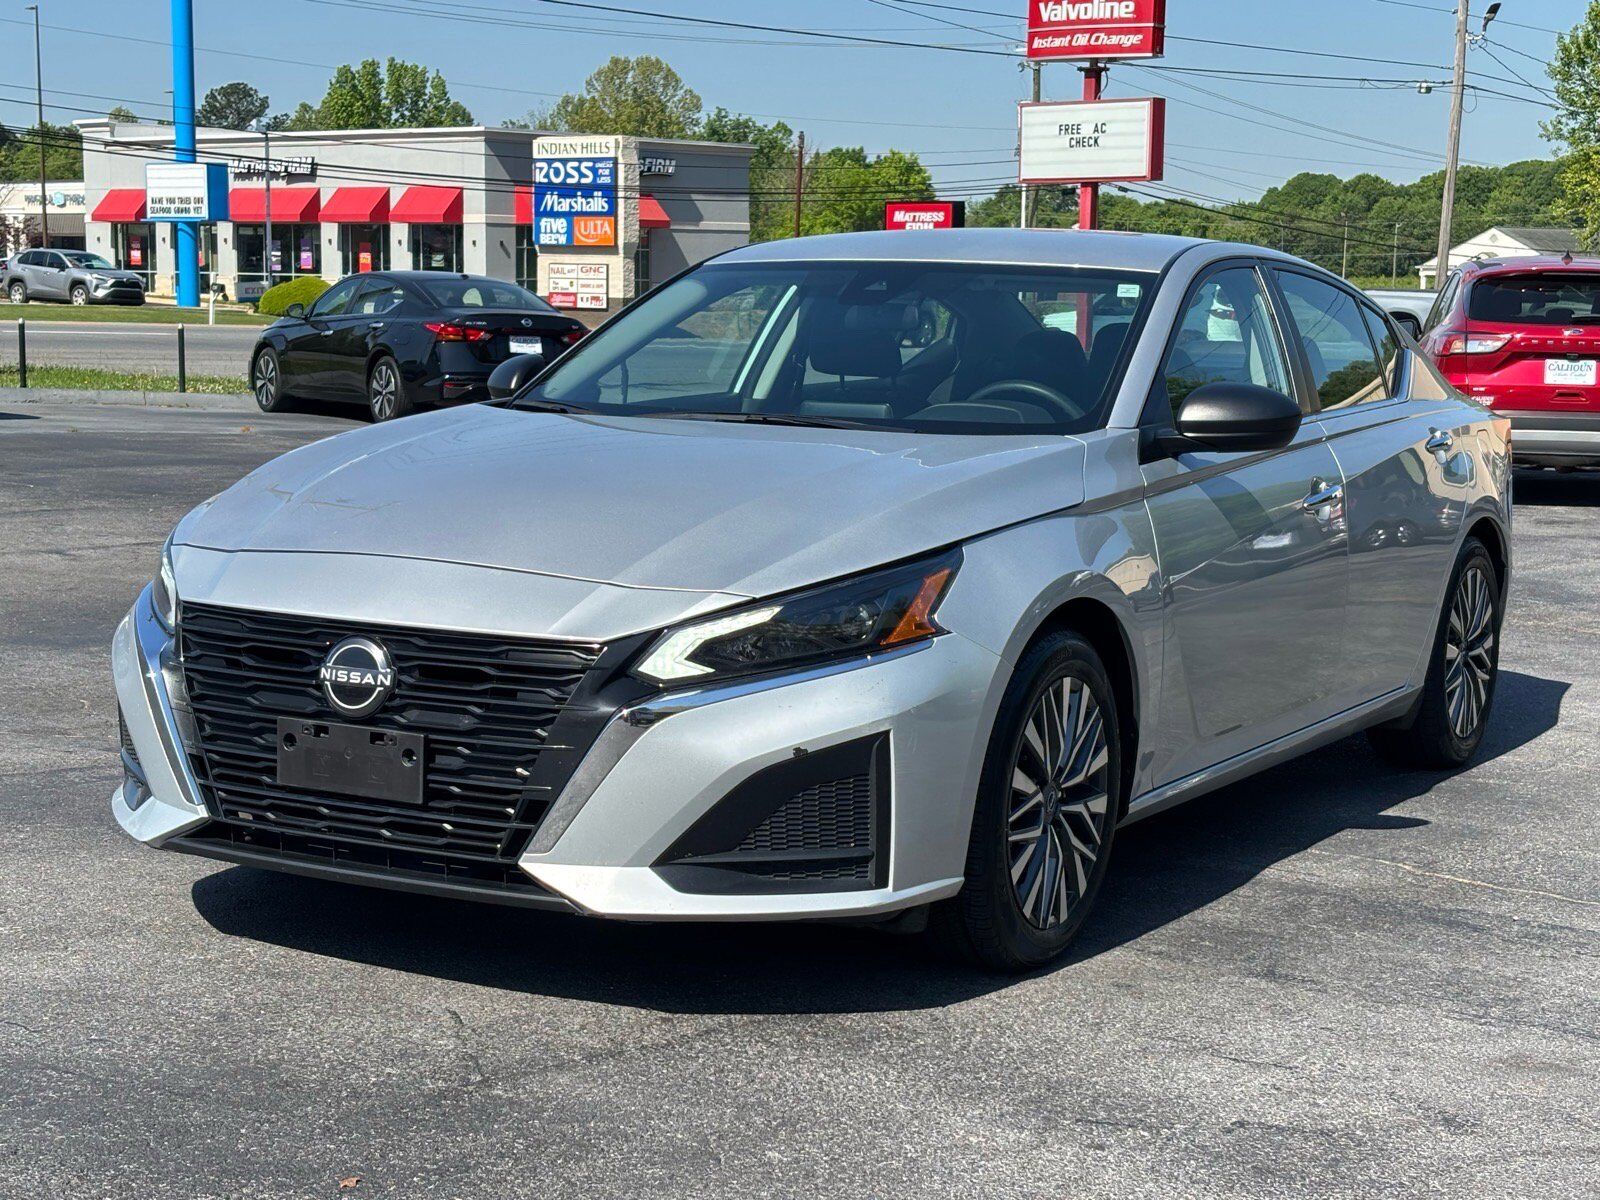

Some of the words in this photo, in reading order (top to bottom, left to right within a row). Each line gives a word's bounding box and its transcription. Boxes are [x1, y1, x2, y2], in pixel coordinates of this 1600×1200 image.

[1038, 0, 1135, 22] Valvoline
[1032, 35, 1071, 49] Instant
[1071, 33, 1090, 46] Oil
[1090, 33, 1143, 47] Change
[1058, 123, 1082, 136] FREE
[1093, 122, 1107, 134] AC
[537, 142, 578, 155] INDIAN
[580, 141, 610, 155] HILLS
[1069, 136, 1100, 148] CHECK
[535, 161, 594, 184] ROSS
[540, 190, 609, 212] Marshalls
[193, 206, 203, 215] YET
[892, 211, 945, 222] MATTRESS
[540, 218, 568, 233] five
[581, 219, 611, 234] ULTA
[580, 266, 604, 274] GNC
[1548, 363, 1593, 372] CALHOUN
[319, 667, 392, 686] NISSAN
